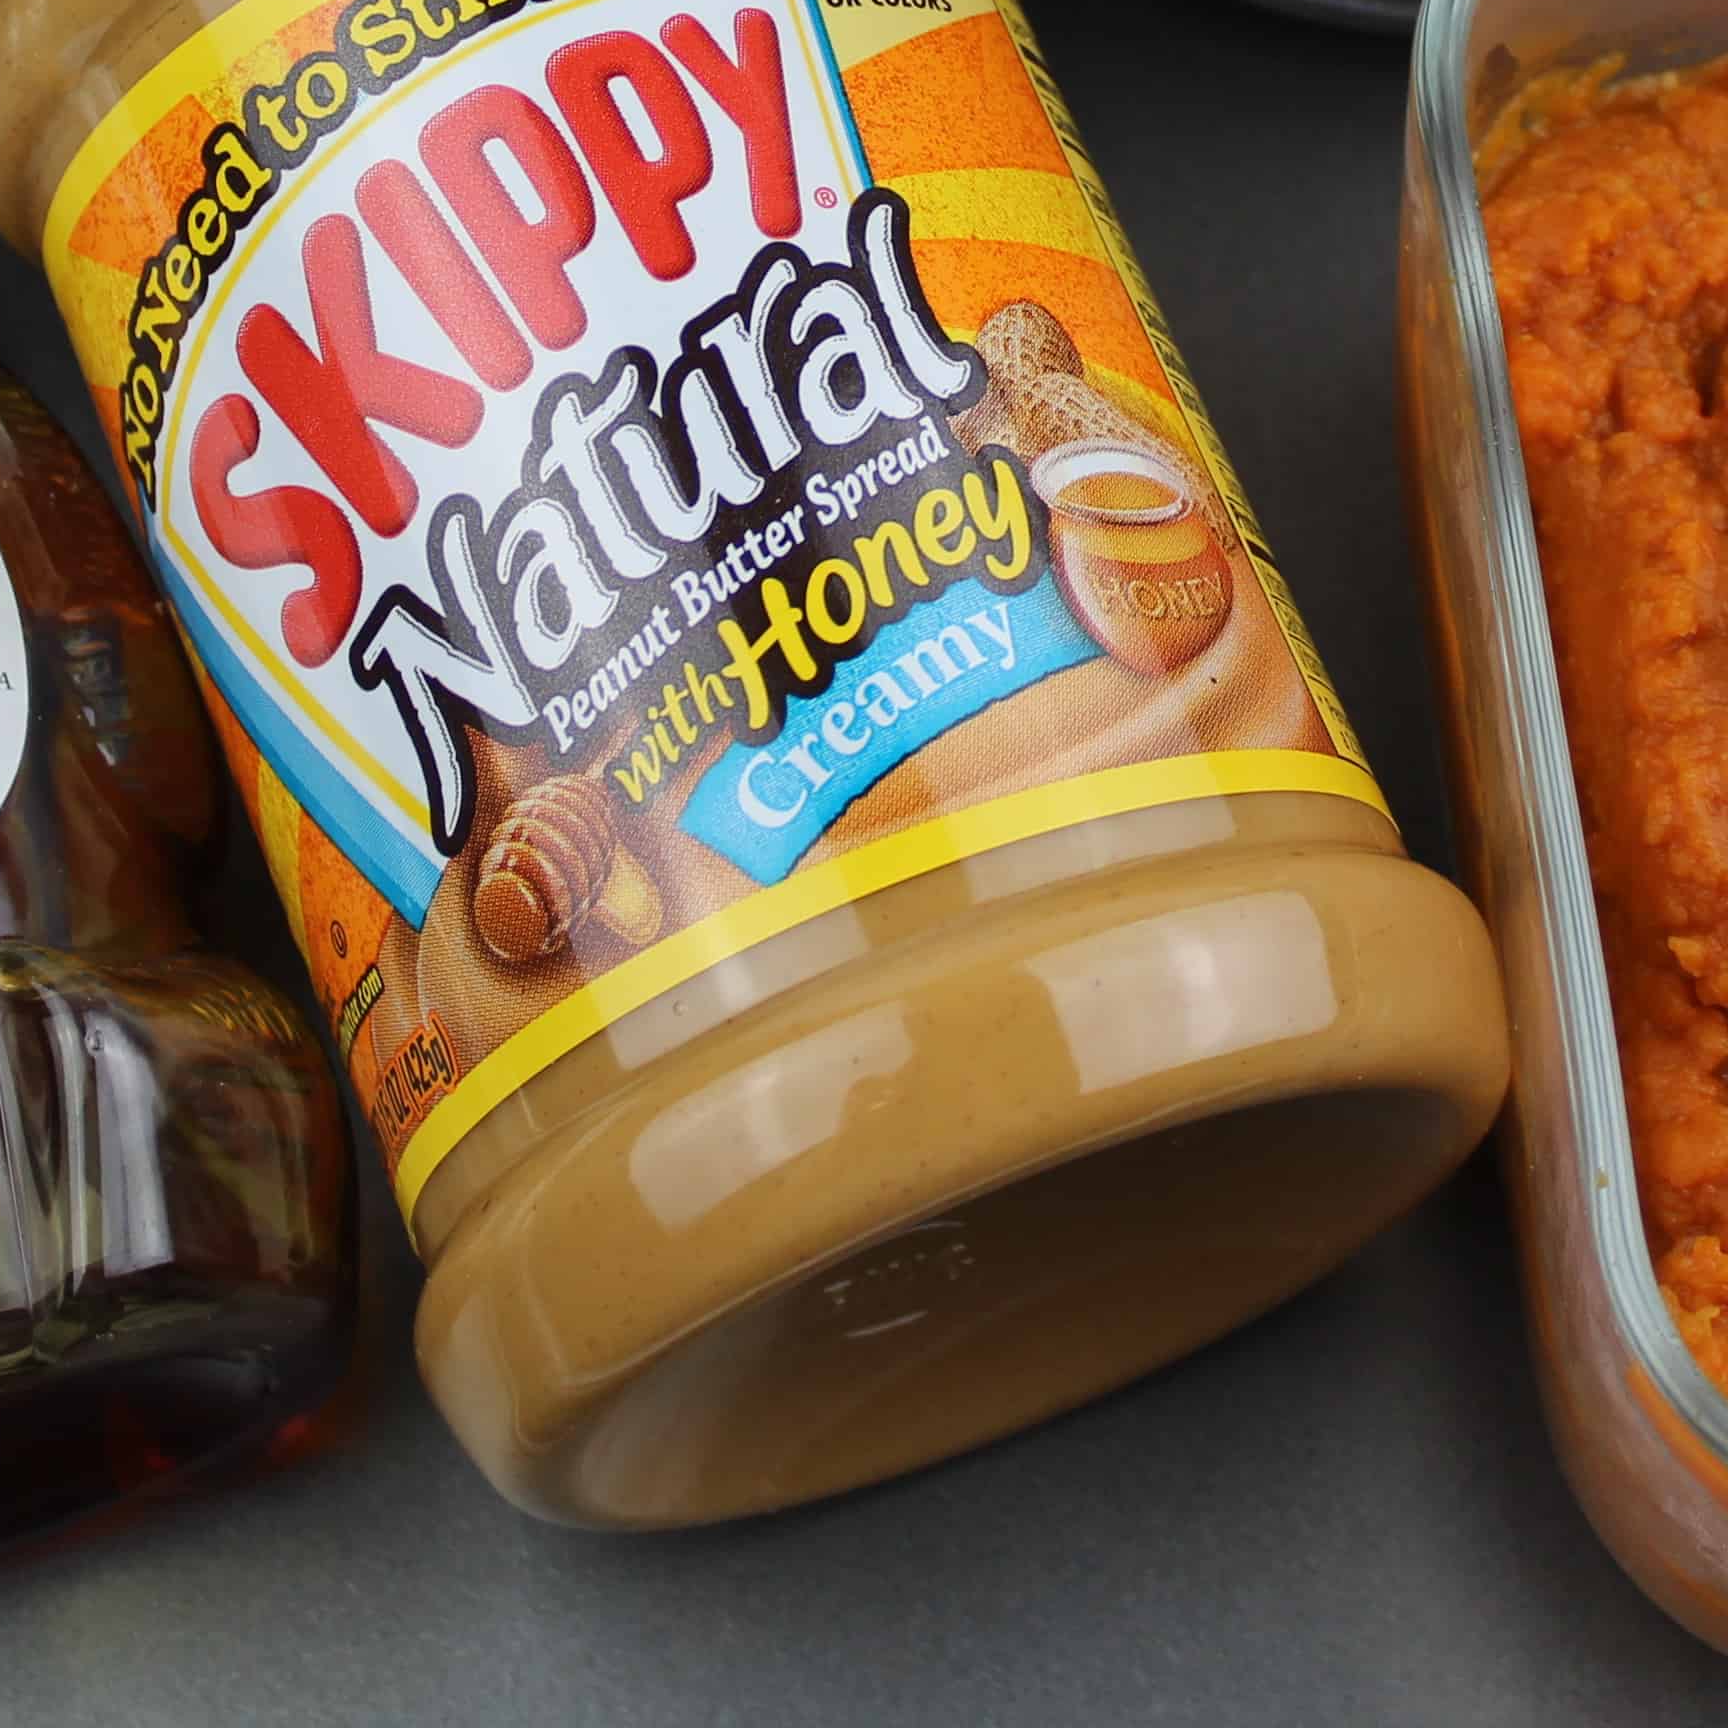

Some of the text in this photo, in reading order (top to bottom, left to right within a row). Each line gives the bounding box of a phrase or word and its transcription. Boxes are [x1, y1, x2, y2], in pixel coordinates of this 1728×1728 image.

[134, 134, 273, 374] Need
[256, 60, 350, 153] to
[190, 7, 803, 669] SKIPPY
[360, 201, 972, 839] Natural
[543, 415, 951, 755] Peanut Butter Spread
[613, 662, 735, 804] with
[717, 458, 1033, 731] Honey
[1090, 570, 1229, 619] HONEY
[736, 600, 1020, 829] Creamy
